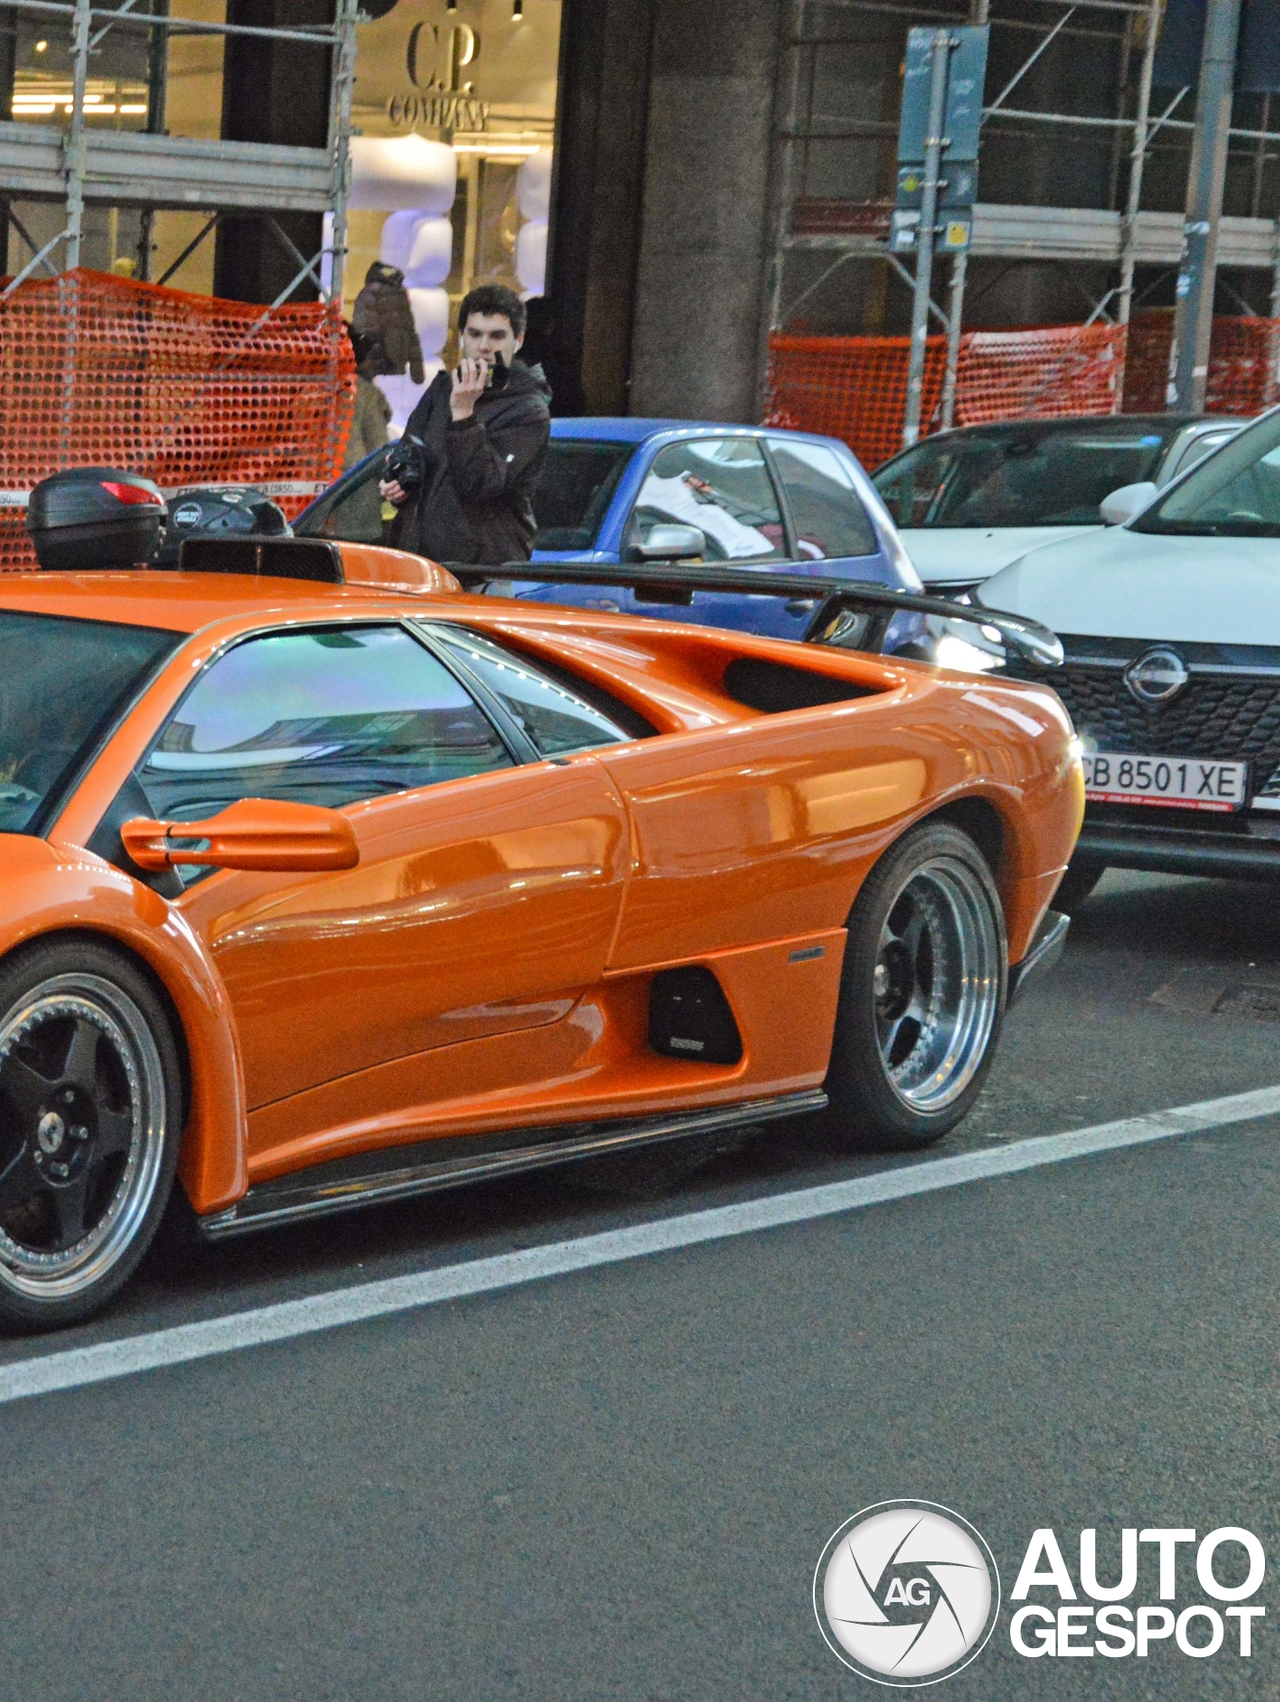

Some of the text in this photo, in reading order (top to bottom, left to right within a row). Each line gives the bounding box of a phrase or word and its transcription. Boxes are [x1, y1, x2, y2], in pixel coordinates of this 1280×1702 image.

[406, 20, 481, 94] C.P.
[1118, 760, 1187, 794] 8501
[1197, 765, 1237, 797] XE
